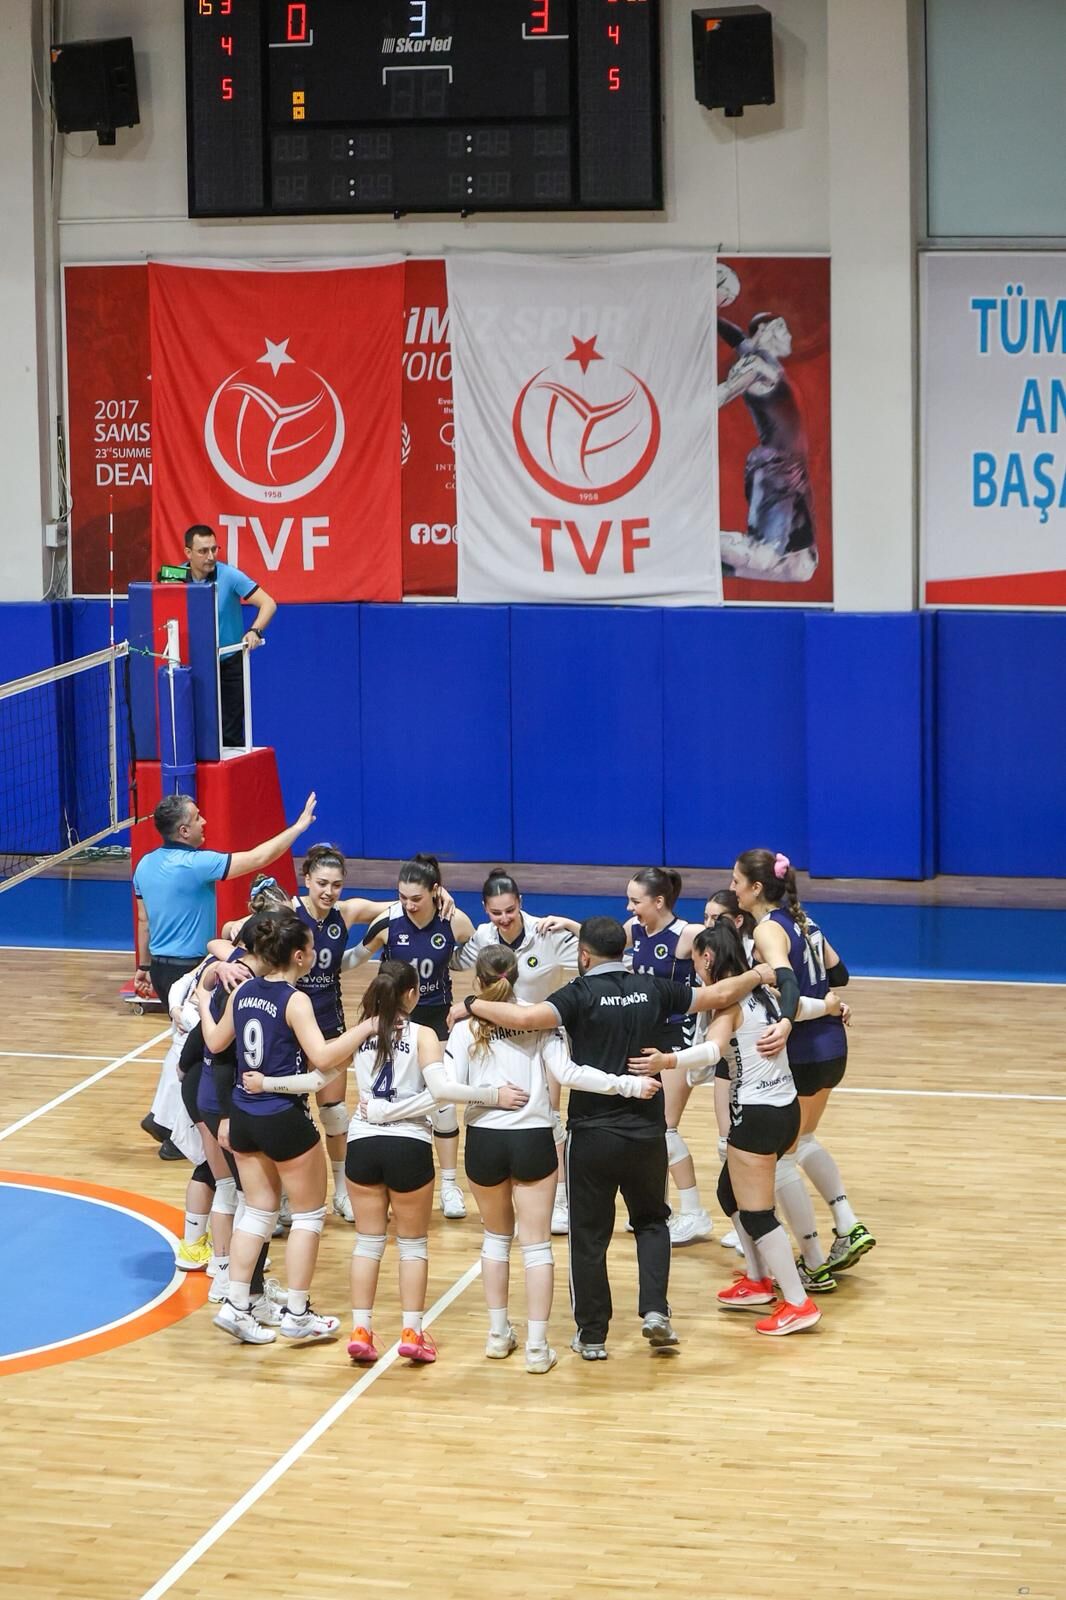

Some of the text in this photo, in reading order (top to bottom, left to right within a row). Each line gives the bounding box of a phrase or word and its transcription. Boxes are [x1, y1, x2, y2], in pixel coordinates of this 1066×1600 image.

[288, 4, 307, 41] 0
[408, 1, 425, 37] 3
[531, 0, 548, 33] 3
[221, 36, 232, 55] 4
[396, 37, 452, 53] Skorled
[608, 25, 619, 45] 4
[222, 79, 233, 99] 5
[609, 68, 620, 90] 5
[971, 284, 1066, 354] TÜM
[94, 400, 139, 420] 2017
[94, 423, 150, 442] SAMS
[112, 447, 151, 458] SUMME
[96, 463, 152, 486] DEA
[579, 493, 598, 501] 1958
[973, 452, 1066, 524] BAŞ
[218, 514, 330, 571] TVF
[530, 517, 650, 575] TVF
[243, 1018, 264, 1069] 9
[371, 1059, 397, 1102] 4
